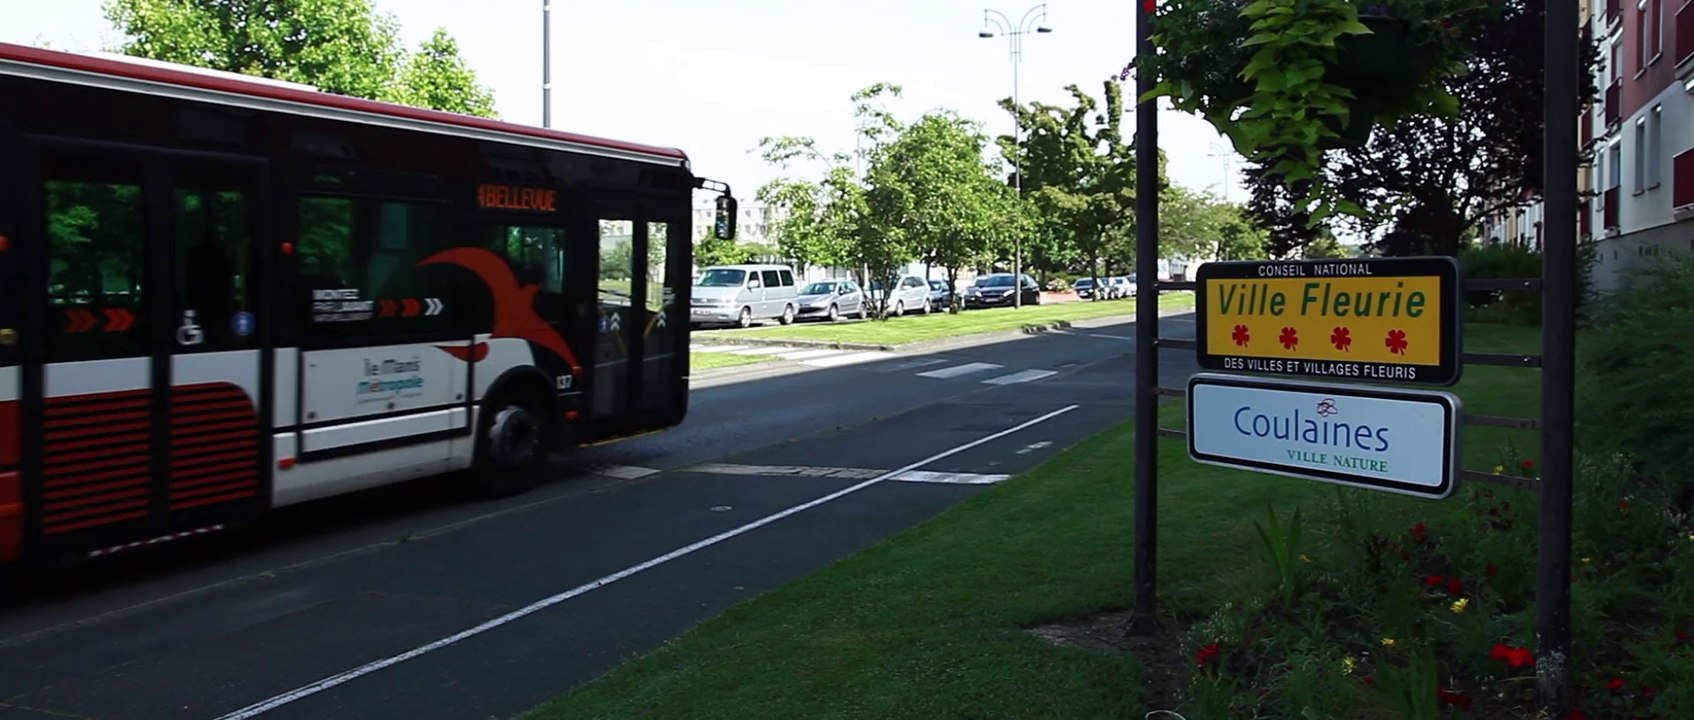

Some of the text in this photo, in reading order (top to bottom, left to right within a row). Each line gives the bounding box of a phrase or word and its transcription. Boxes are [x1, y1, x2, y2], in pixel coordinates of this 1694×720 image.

[1258, 264, 1372, 277] CONSEIL NATIONAL
[1218, 281, 1426, 318] Ville Fleurie
[1224, 357, 1416, 380] DES VILLES ET VILLAGES FLEURIS
[1234, 406, 1389, 452] Coulaines
[1287, 449, 1389, 473] VILLE NATURE
